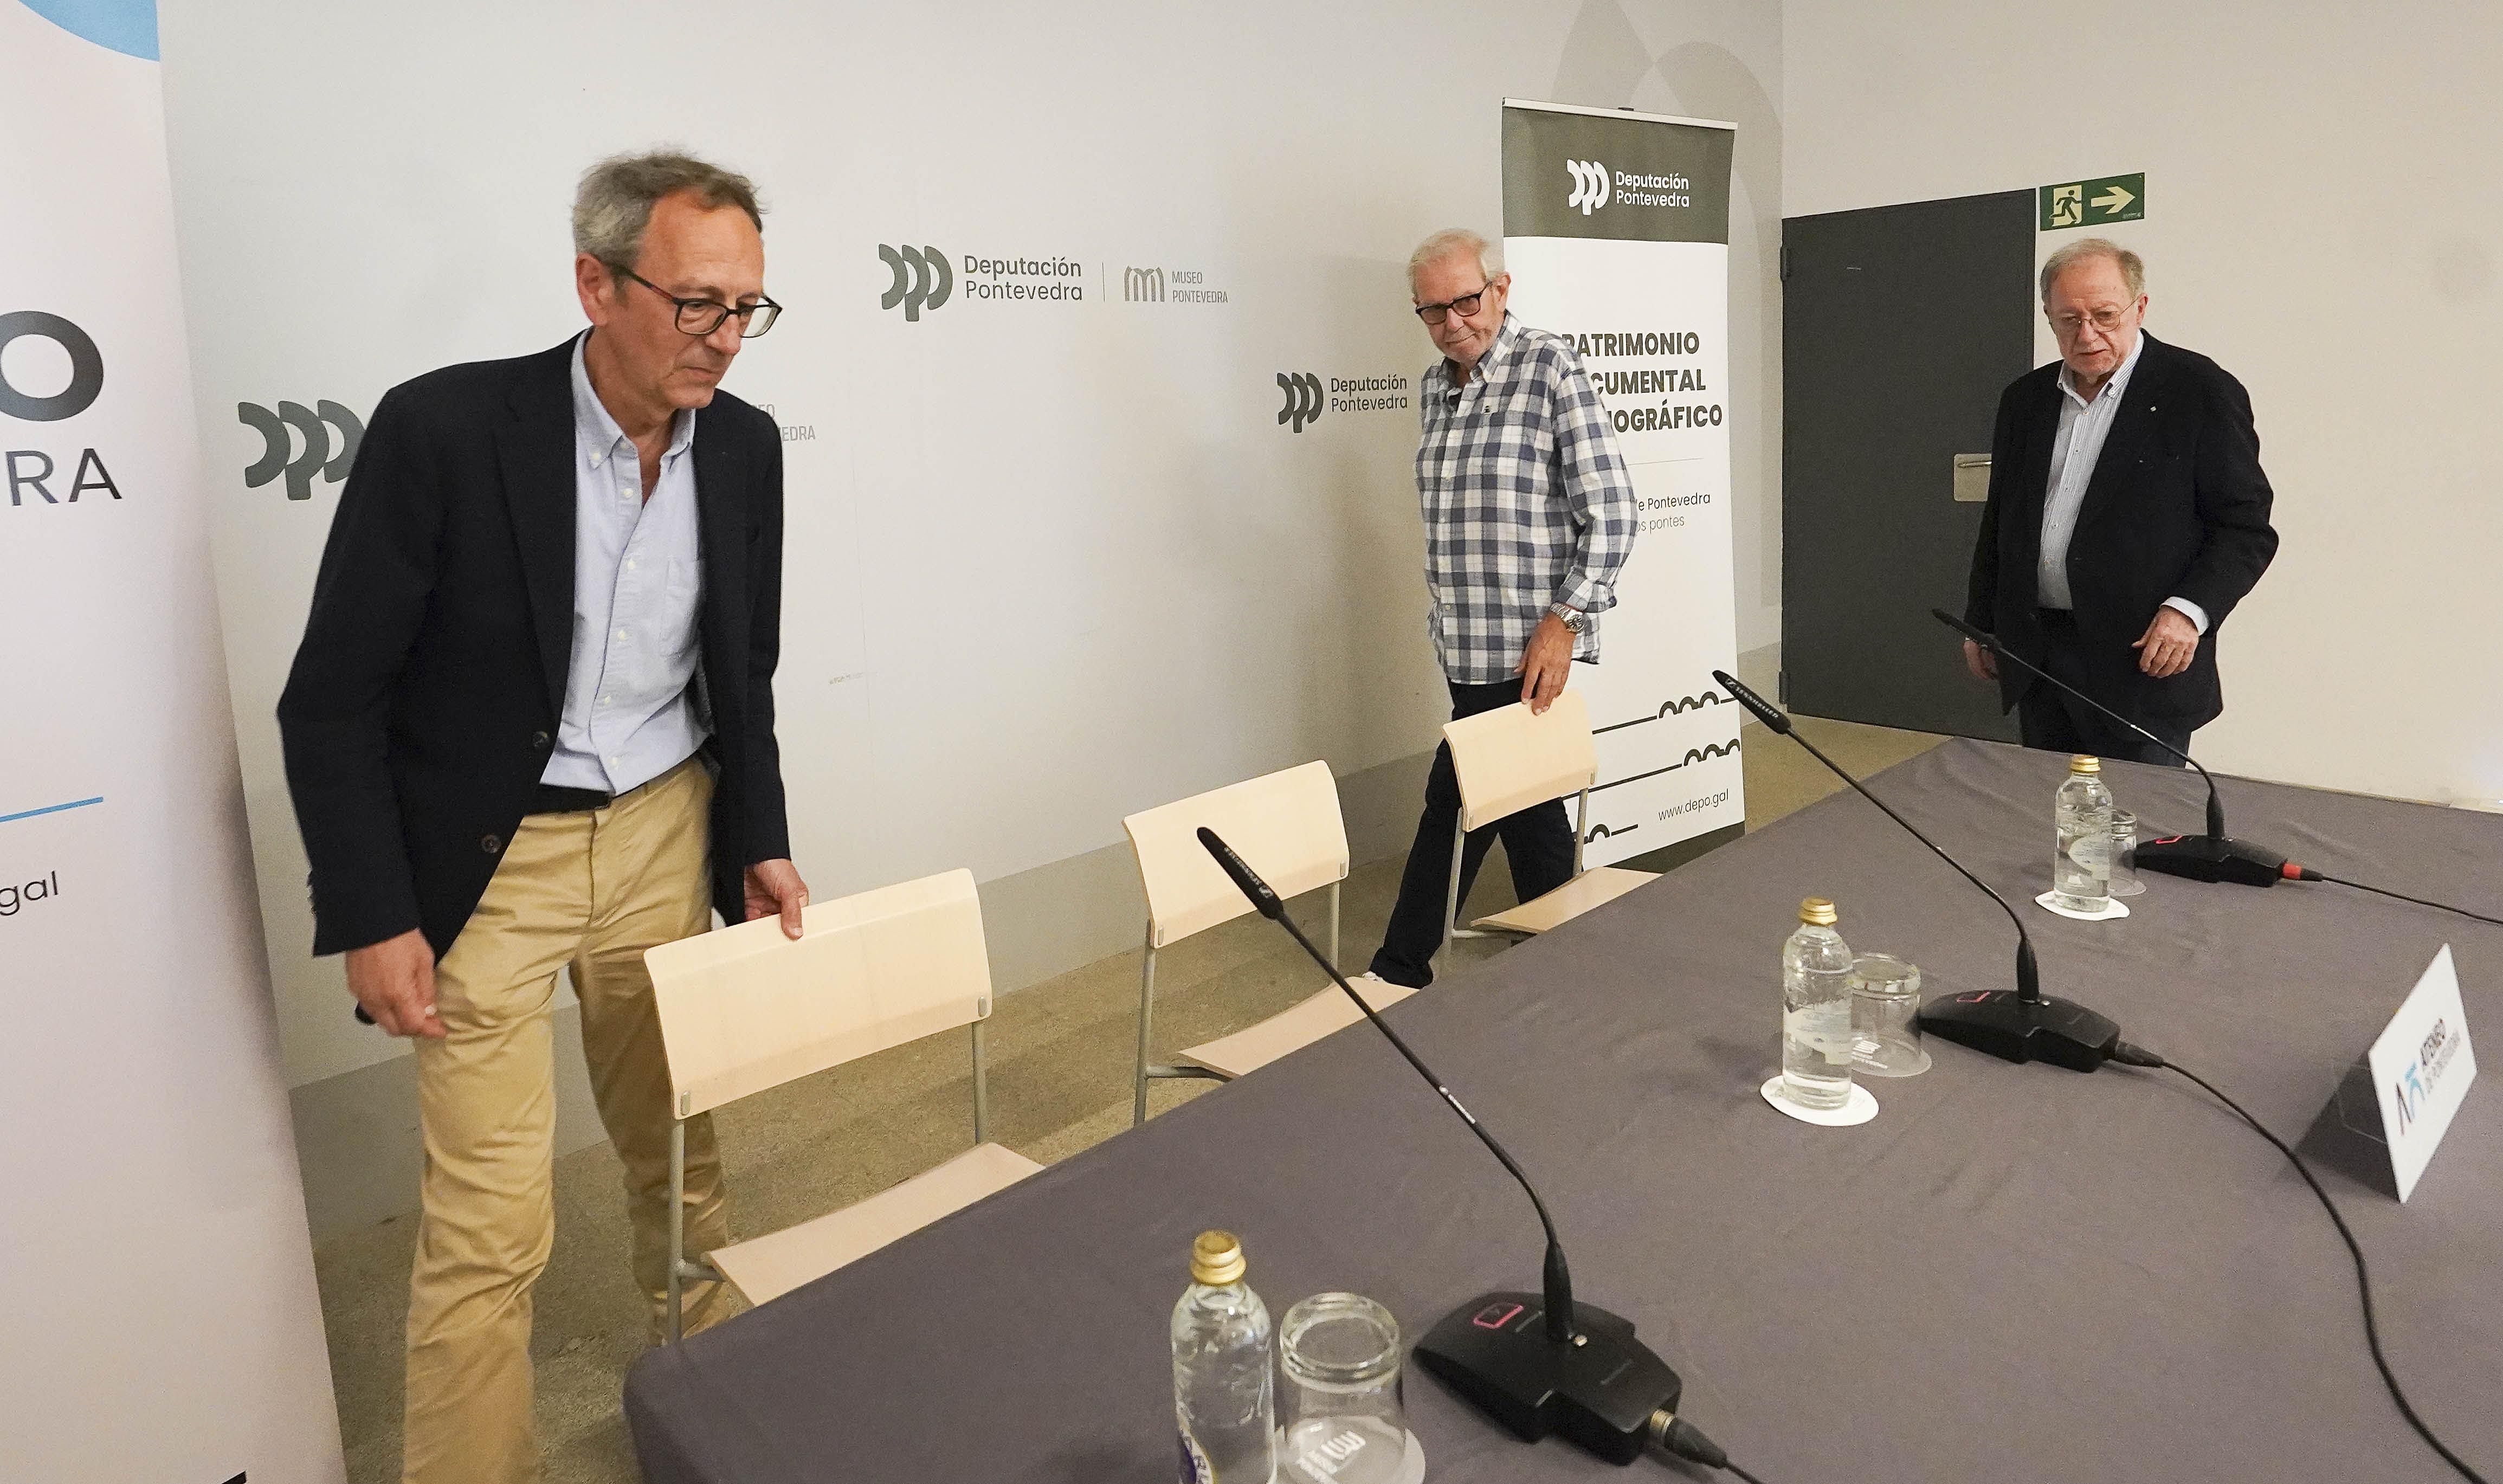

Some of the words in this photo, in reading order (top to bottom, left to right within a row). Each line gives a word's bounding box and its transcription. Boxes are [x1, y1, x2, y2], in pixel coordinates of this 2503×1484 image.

[1616, 171, 1689, 191] Deputación
[1616, 190, 1689, 208] Pontevedra
[965, 256, 1081, 279] Deputación
[1172, 271, 1203, 284] MUSEO
[966, 280, 1082, 301] Pontevedra
[1172, 290, 1228, 303] PONTEVEDRA
[1331, 373, 1407, 397] Deputación
[1591, 369, 1706, 395] CUMENTAL
[1332, 395, 1408, 412] Pontevedra
[1608, 399, 1723, 433] OGRÁFICO
[6, 448, 122, 506] RA
[1636, 498, 1644, 511] e
[1648, 492, 1710, 510] Pontevedra
[1650, 516, 1685, 534] pontes
[1659, 788, 1728, 821] www.depo.gal
